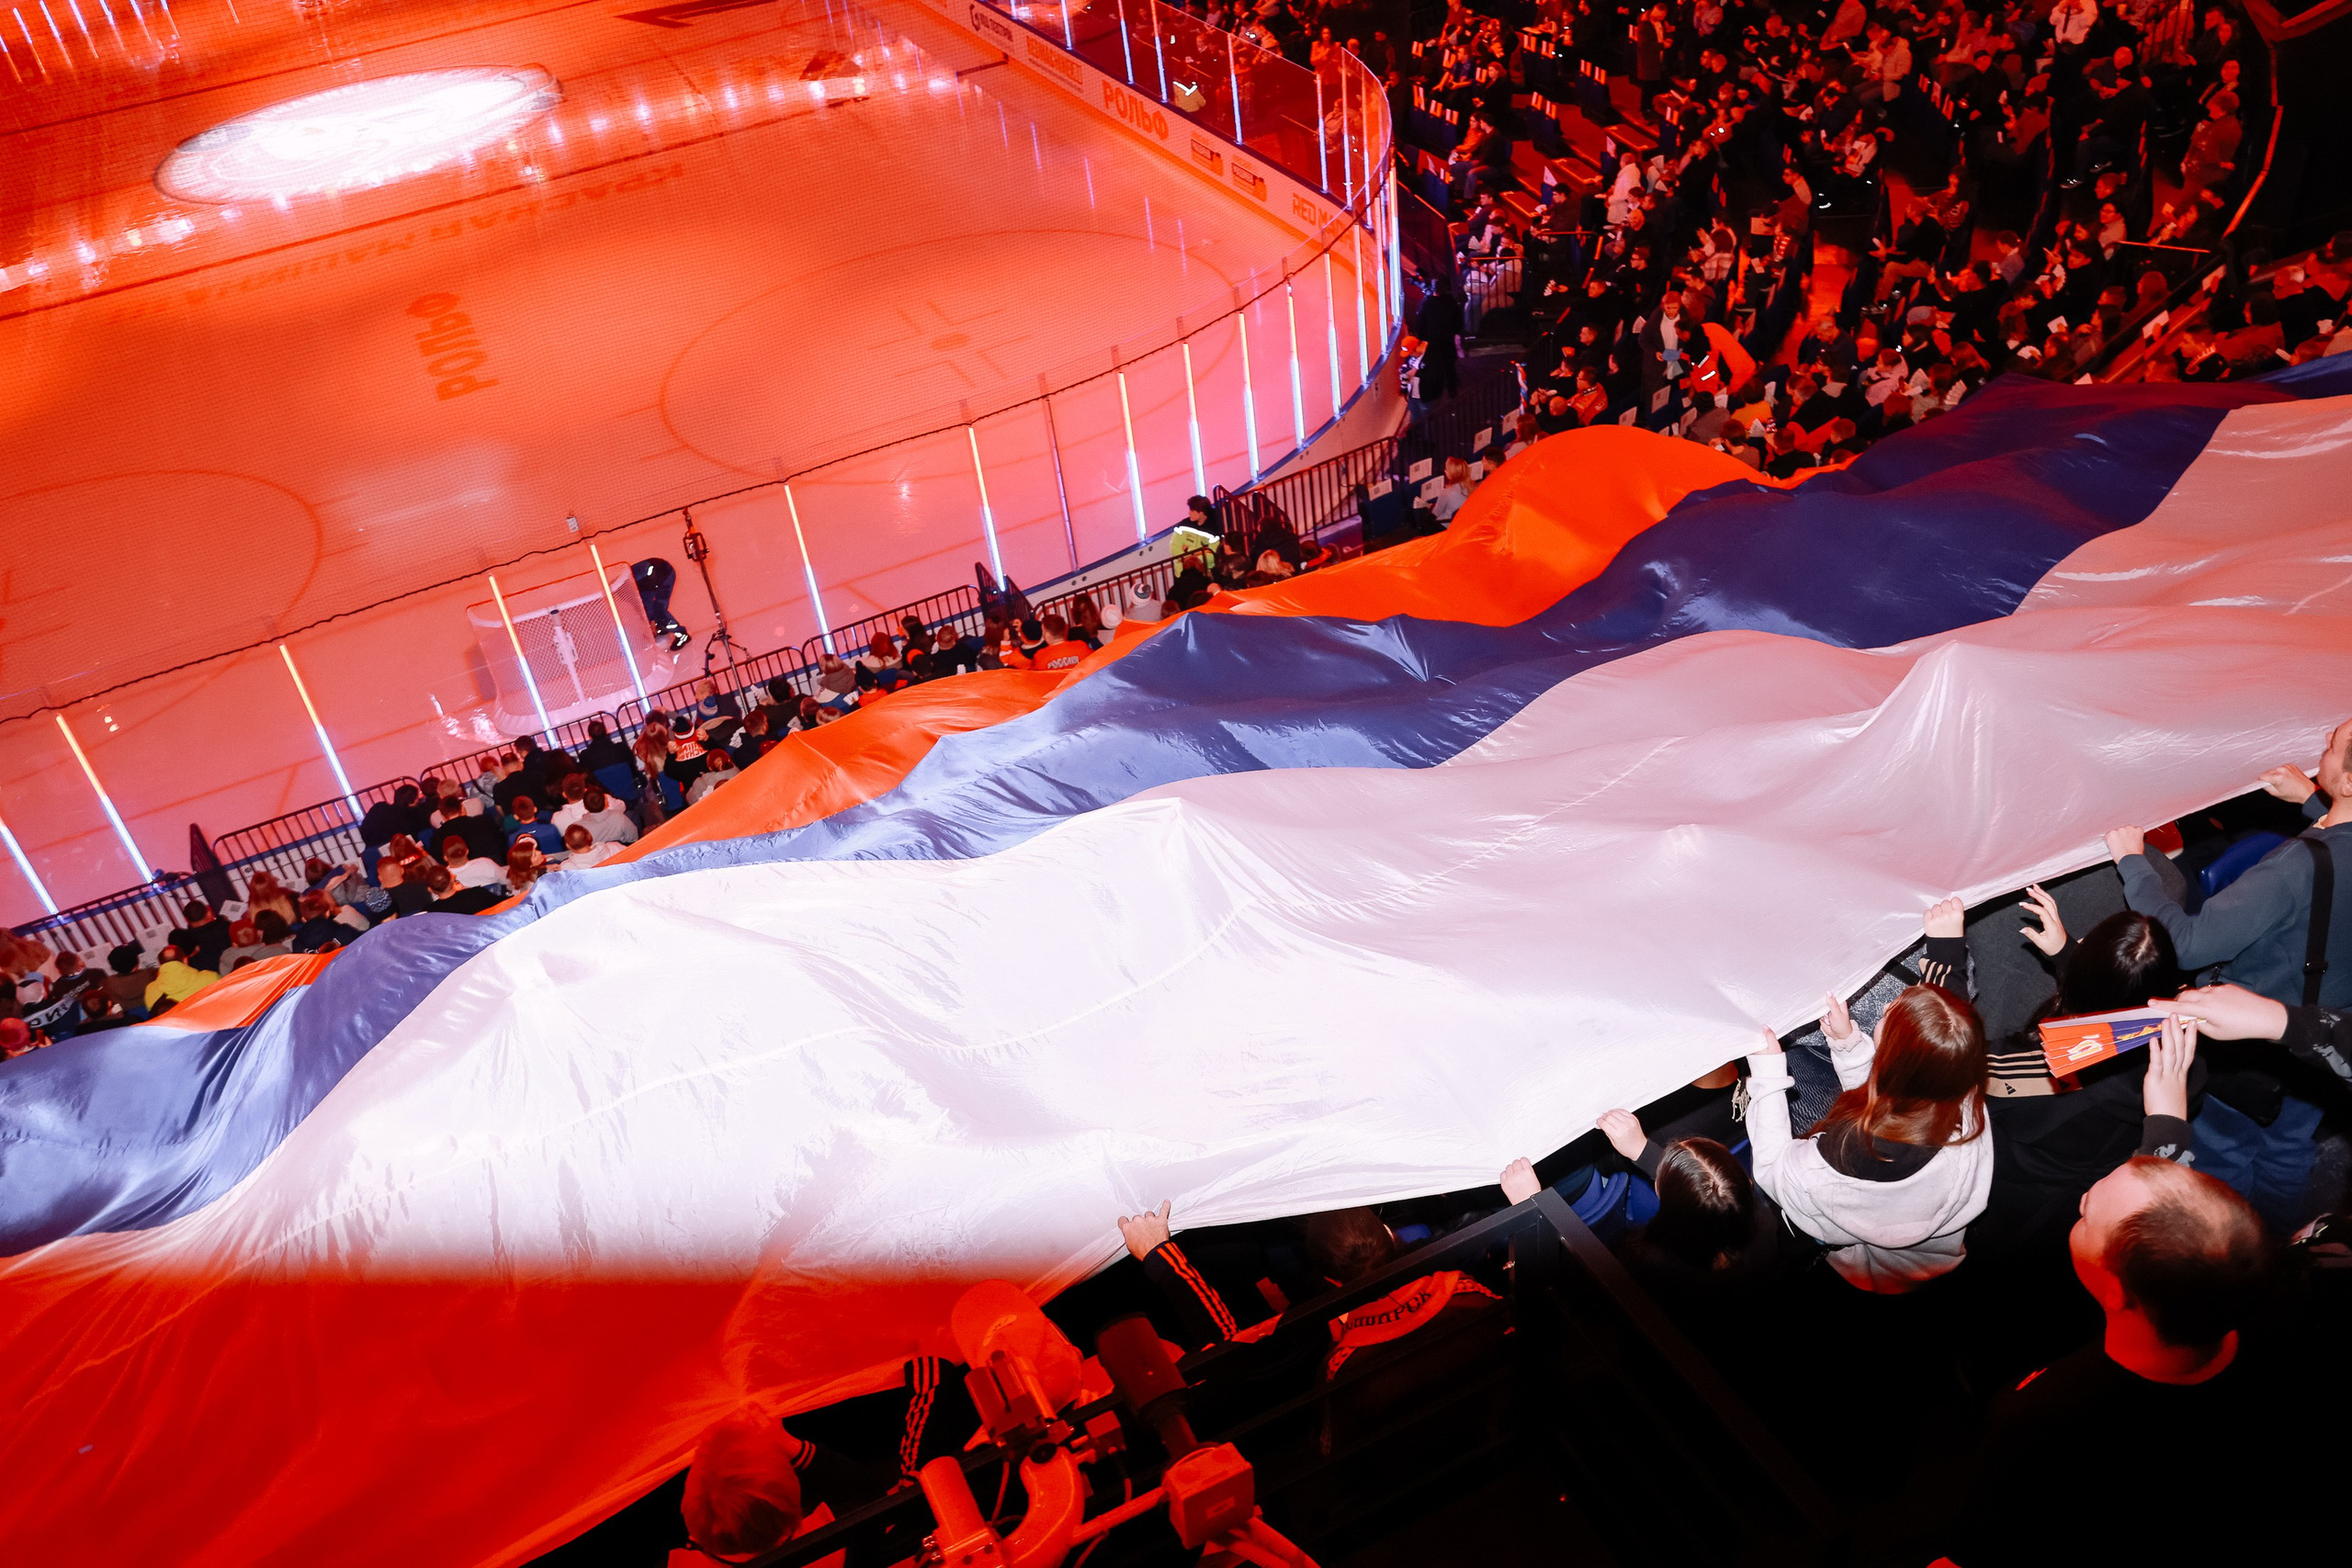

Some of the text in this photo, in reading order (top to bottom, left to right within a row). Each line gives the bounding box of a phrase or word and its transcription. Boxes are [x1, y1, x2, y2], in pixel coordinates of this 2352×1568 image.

[1101, 79, 1170, 141] РОЛЬФ
[1292, 192, 1317, 226] RED
[405, 291, 500, 401] РОЛЬФ
